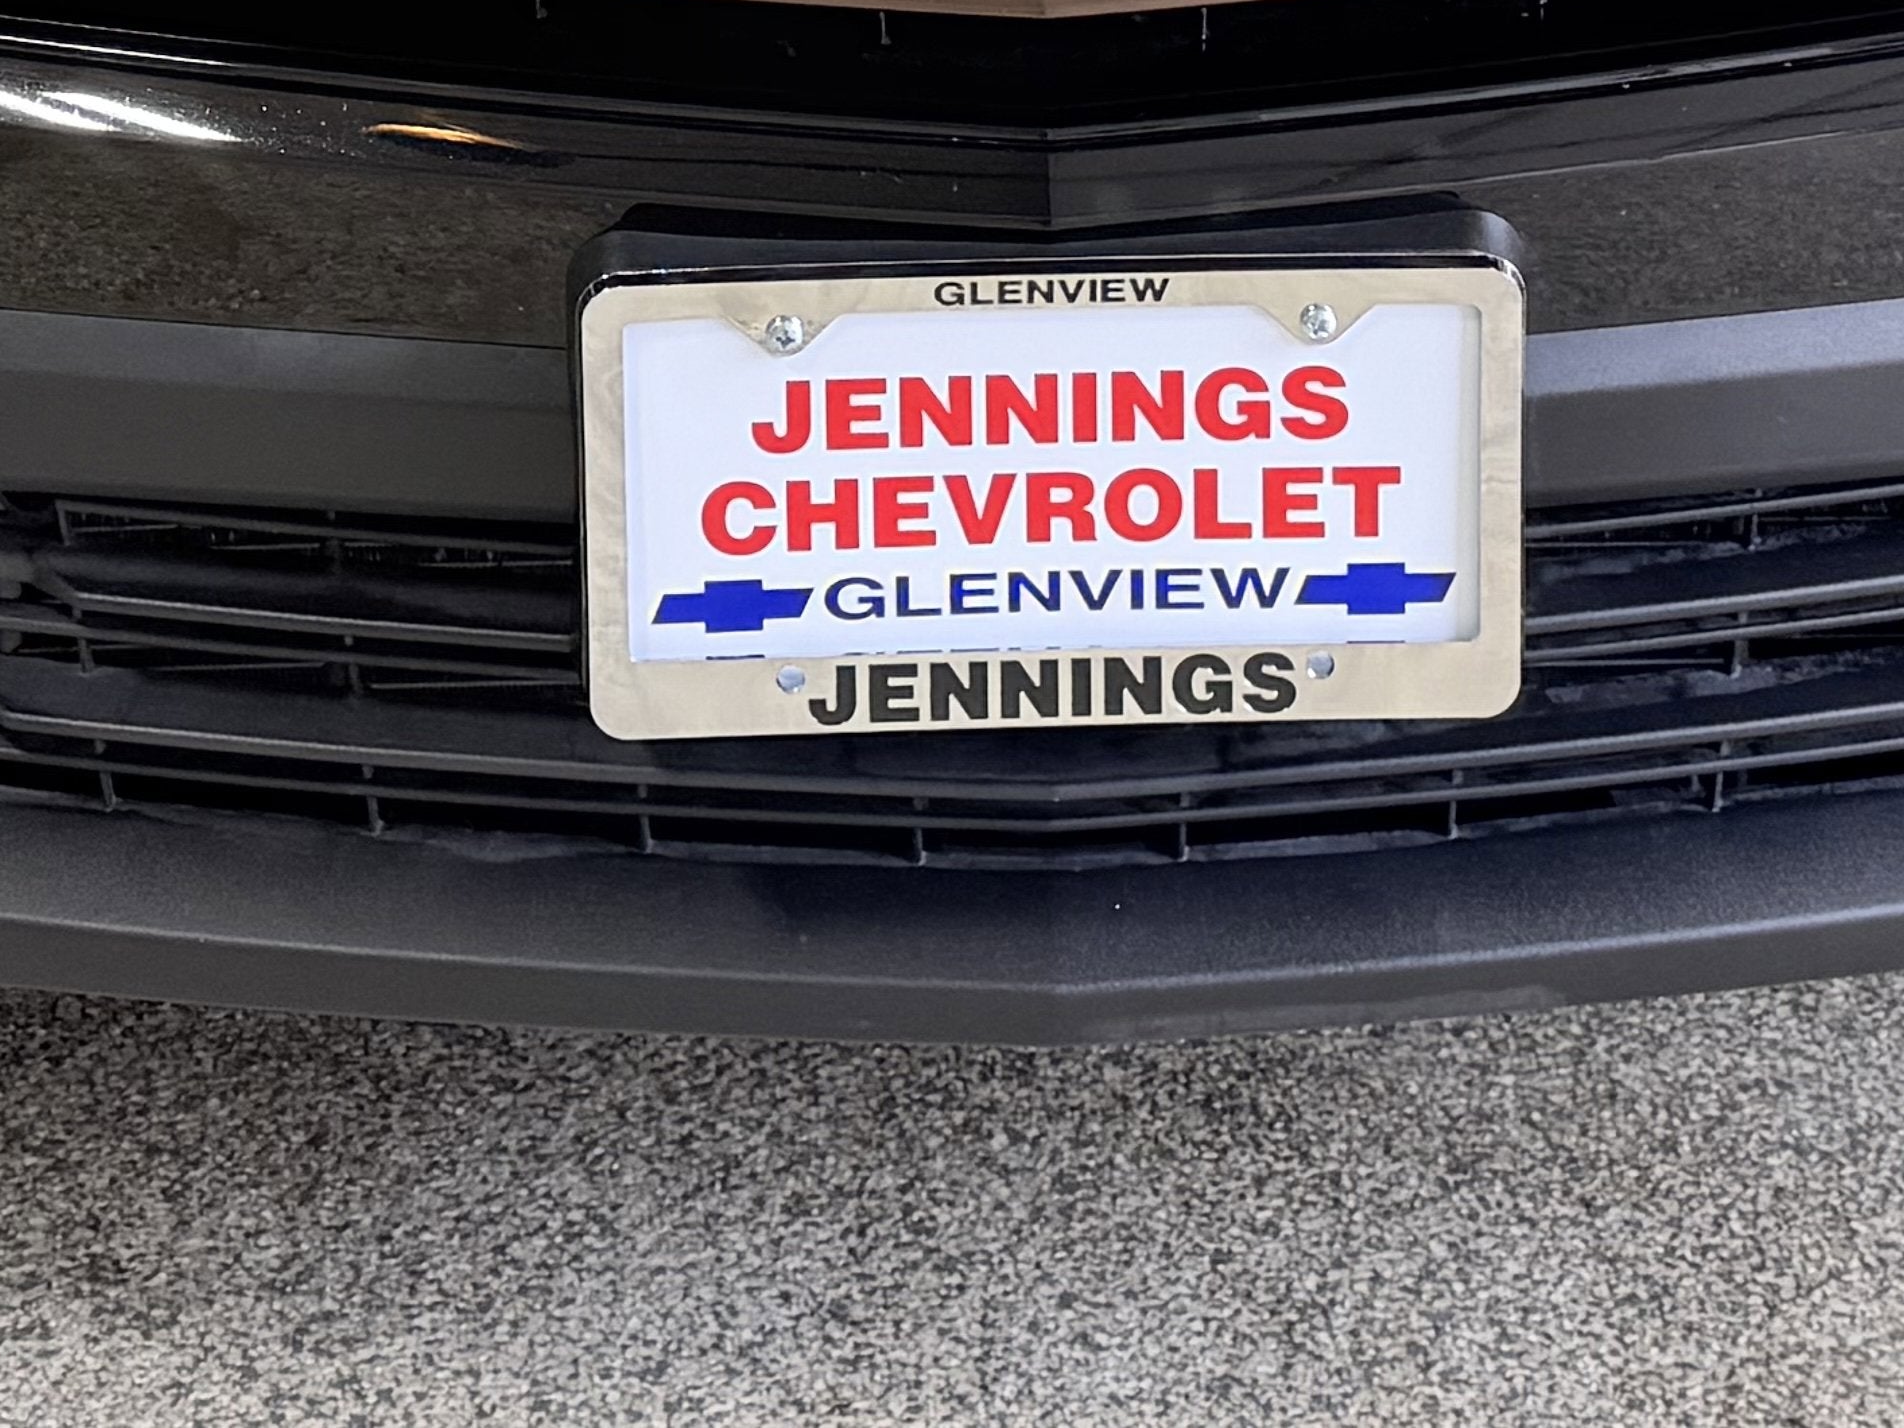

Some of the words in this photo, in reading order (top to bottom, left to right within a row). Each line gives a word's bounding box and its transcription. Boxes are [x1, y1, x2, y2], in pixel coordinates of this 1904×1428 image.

[933, 277, 1171, 307] GLENVIEW
[751, 365, 1350, 455] JENNINGS
[701, 465, 1402, 556] CHEVROLET
[823, 566, 1292, 621] GLENVIEW
[807, 651, 1298, 726] JENNINGS
